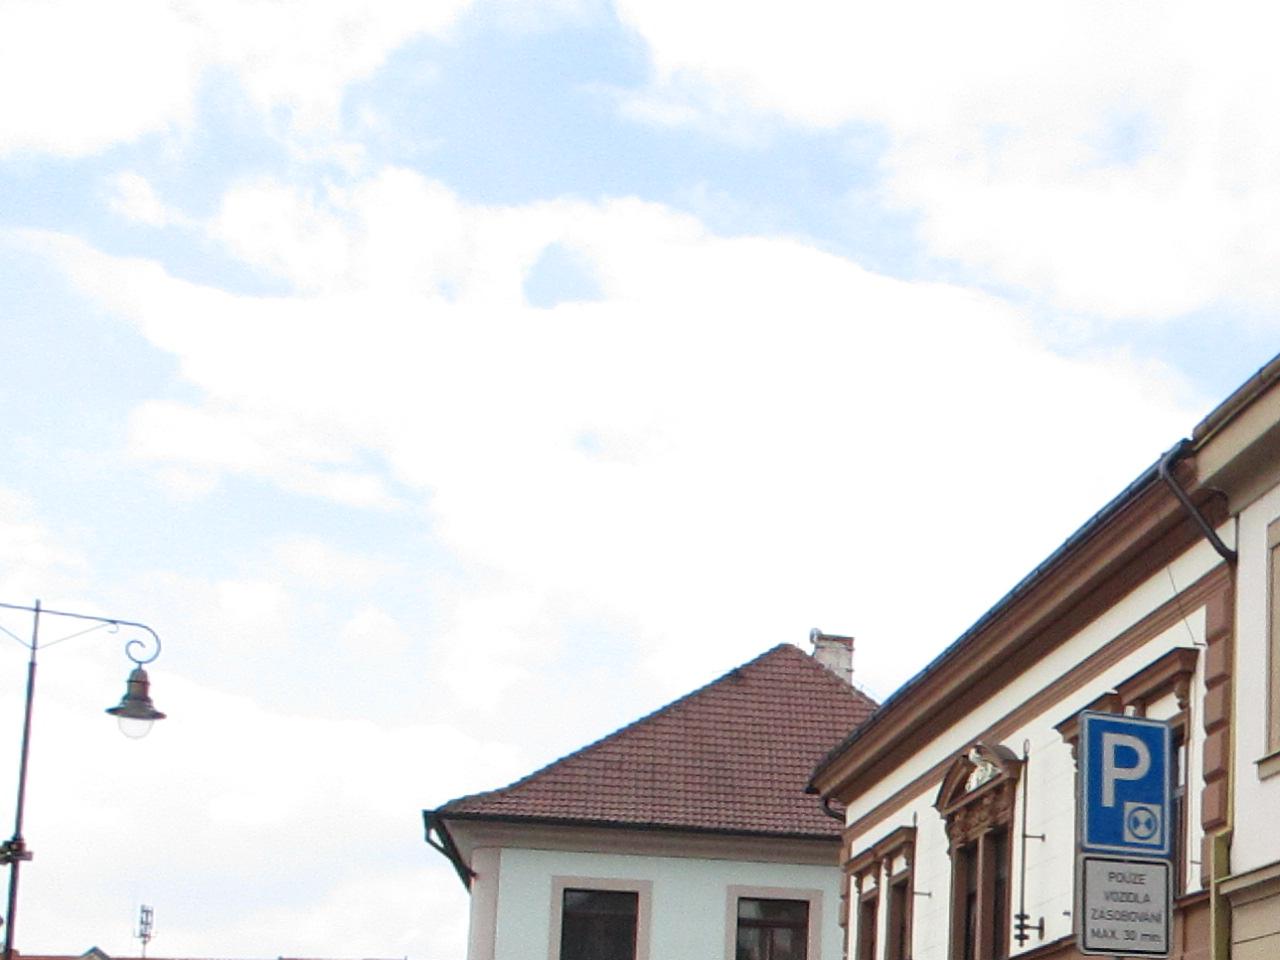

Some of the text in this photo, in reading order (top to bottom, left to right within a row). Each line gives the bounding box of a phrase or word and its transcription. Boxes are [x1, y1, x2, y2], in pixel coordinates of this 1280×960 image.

[1102, 732, 1151, 808] P
[1108, 871, 1147, 885] POUZE
[1104, 891, 1151, 904] VOZIDLA
